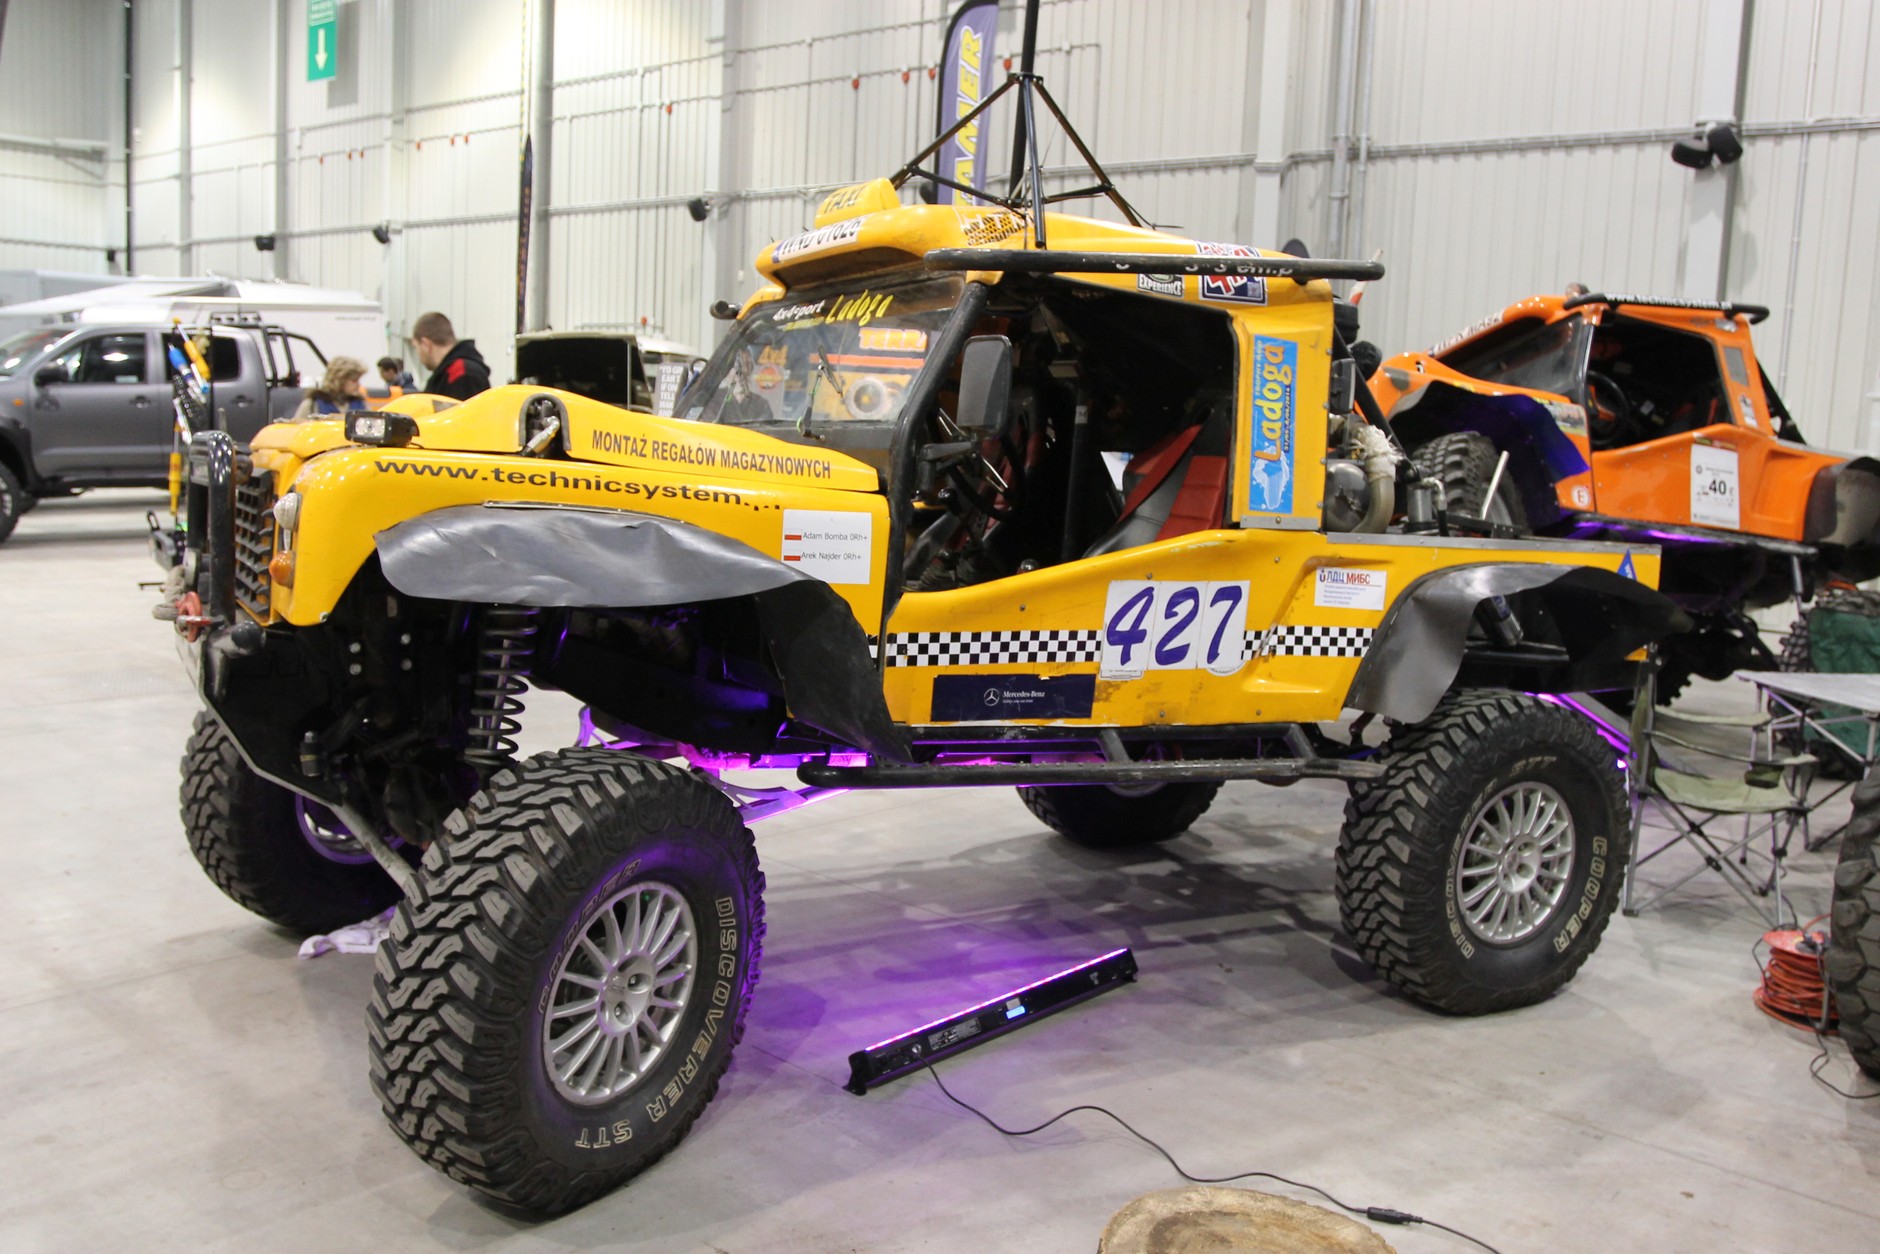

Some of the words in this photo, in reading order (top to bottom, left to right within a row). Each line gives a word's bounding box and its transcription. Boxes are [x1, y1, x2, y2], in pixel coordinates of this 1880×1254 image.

[1139, 276, 1183, 297] EXPERIENCE
[825, 288, 894, 327] Ladoga
[1254, 344, 1293, 462] Ladoga
[591, 429, 647, 458] MONTAŻ
[651, 439, 716, 467] REGAŁÓW
[720, 449, 831, 479] MAGAZYNOWYCH
[374, 461, 781, 512] www.technicsystem.
[1709, 480, 1727, 496] 40
[803, 532, 822, 540] Adam
[824, 532, 848, 541] Bomba
[818, 552, 841, 562] Najder
[1346, 572, 1371, 585] МИБС
[1106, 585, 1243, 666] 427
[1002, 690, 1046, 699] Mercedes-Benz
[1553, 836, 1608, 953] COOPER
[645, 896, 737, 1123] DISCOVERER
[574, 1119, 633, 1149] STT
